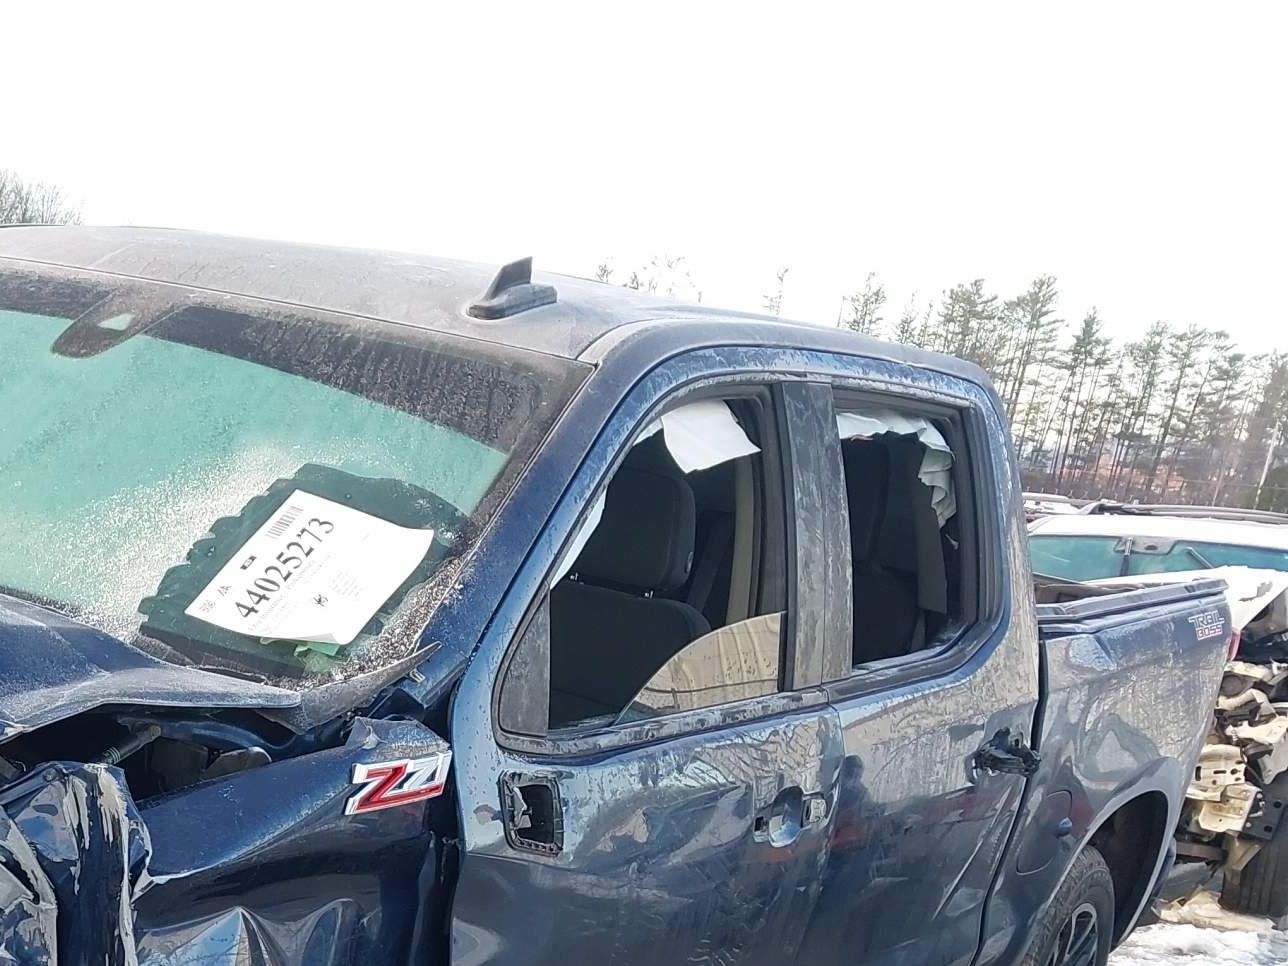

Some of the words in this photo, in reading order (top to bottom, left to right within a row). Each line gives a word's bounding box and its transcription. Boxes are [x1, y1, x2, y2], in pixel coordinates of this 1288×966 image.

[235, 517, 334, 618] 44025273
[1188, 610, 1225, 627] TRAIL
[1196, 624, 1223, 640] BOSS
